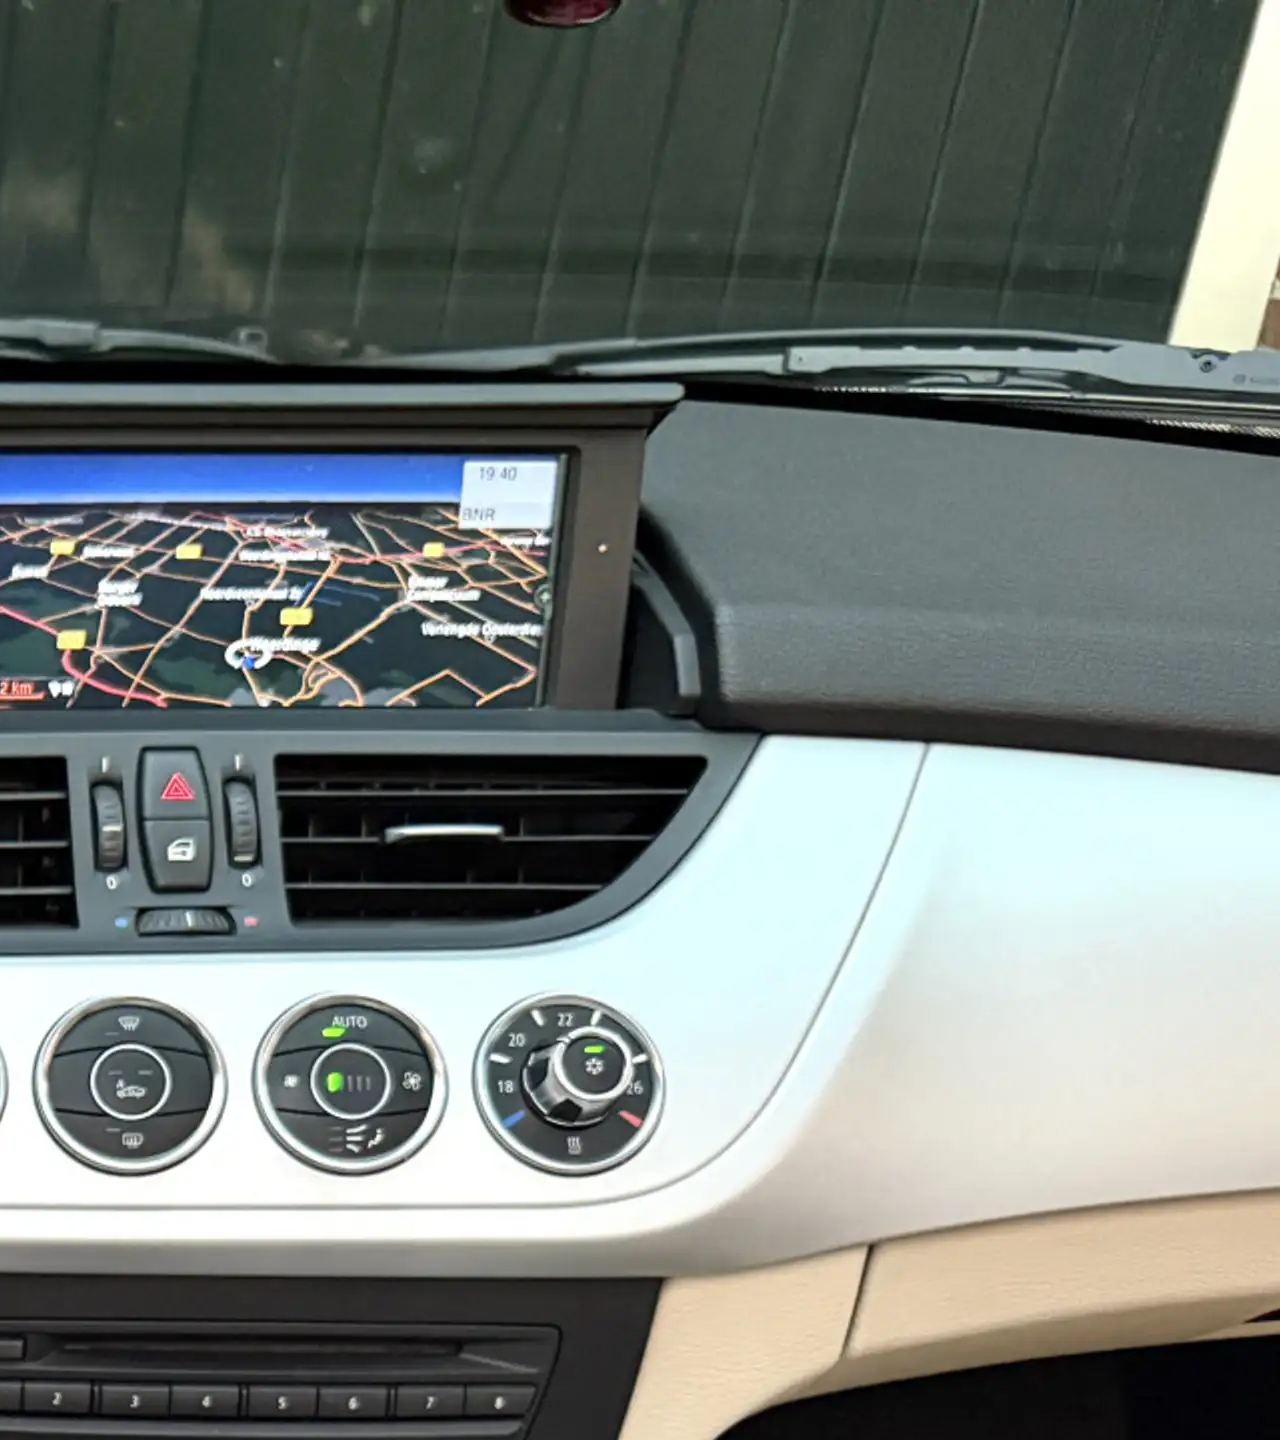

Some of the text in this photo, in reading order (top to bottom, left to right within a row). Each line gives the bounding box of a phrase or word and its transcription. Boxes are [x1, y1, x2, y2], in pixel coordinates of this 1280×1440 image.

[11, 681, 34, 696] km
[331, 1015, 368, 1028] AUTO
[557, 1012, 574, 1027] 22
[508, 1033, 526, 1048] 20
[497, 1079, 514, 1095] 18
[626, 1079, 643, 1096] 26
[52, 1392, 62, 1406] 2
[130, 1394, 140, 1409] 3
[202, 1395, 212, 1408] 4
[277, 1395, 288, 1410] 5
[348, 1395, 359, 1410] 6
[425, 1395, 437, 1410] 7
[493, 1395, 504, 1410] 8
